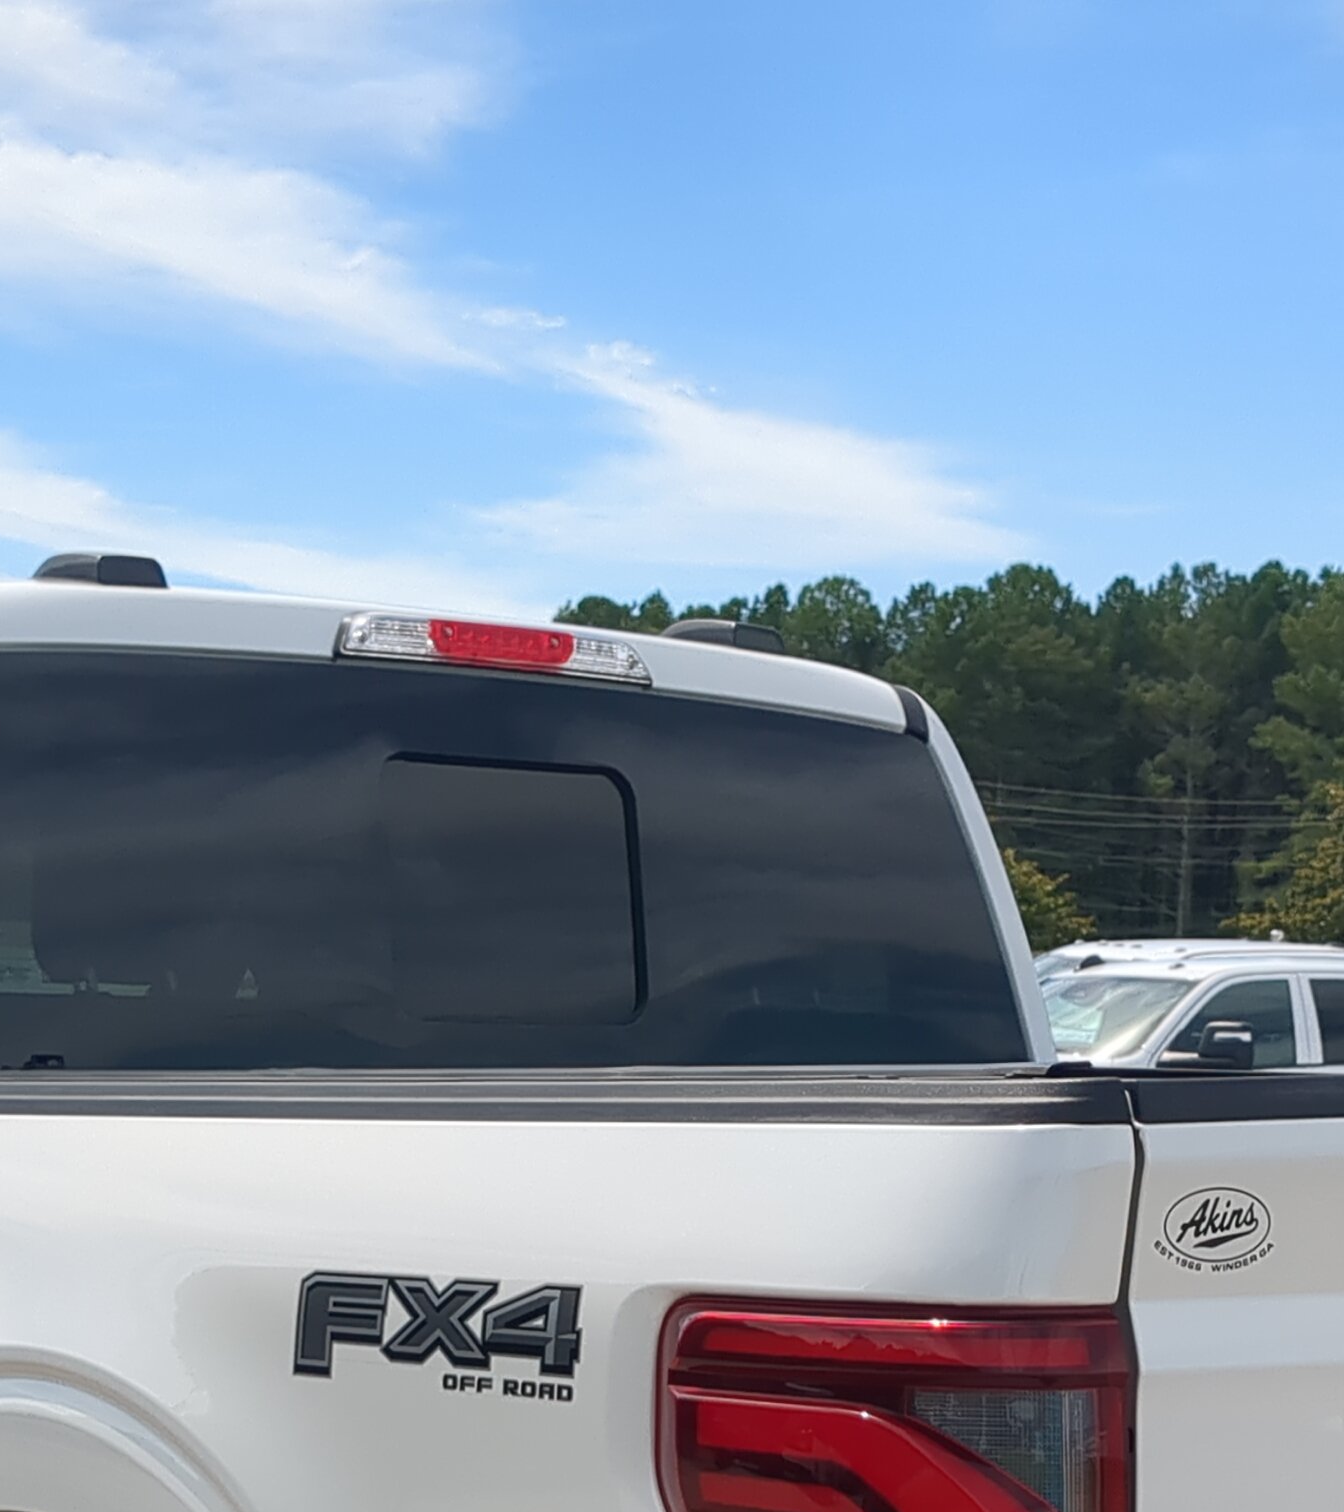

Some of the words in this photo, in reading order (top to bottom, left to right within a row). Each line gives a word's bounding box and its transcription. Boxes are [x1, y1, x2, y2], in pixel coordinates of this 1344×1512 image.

[1176, 1196, 1258, 1245] Akins
[1153, 1239, 1174, 1261] EST
[1211, 1254, 1258, 1272] WINDER
[1258, 1242, 1275, 1258] GA
[293, 1270, 584, 1379] FX4
[442, 1374, 494, 1394] OFF
[502, 1378, 575, 1402] ROAD
